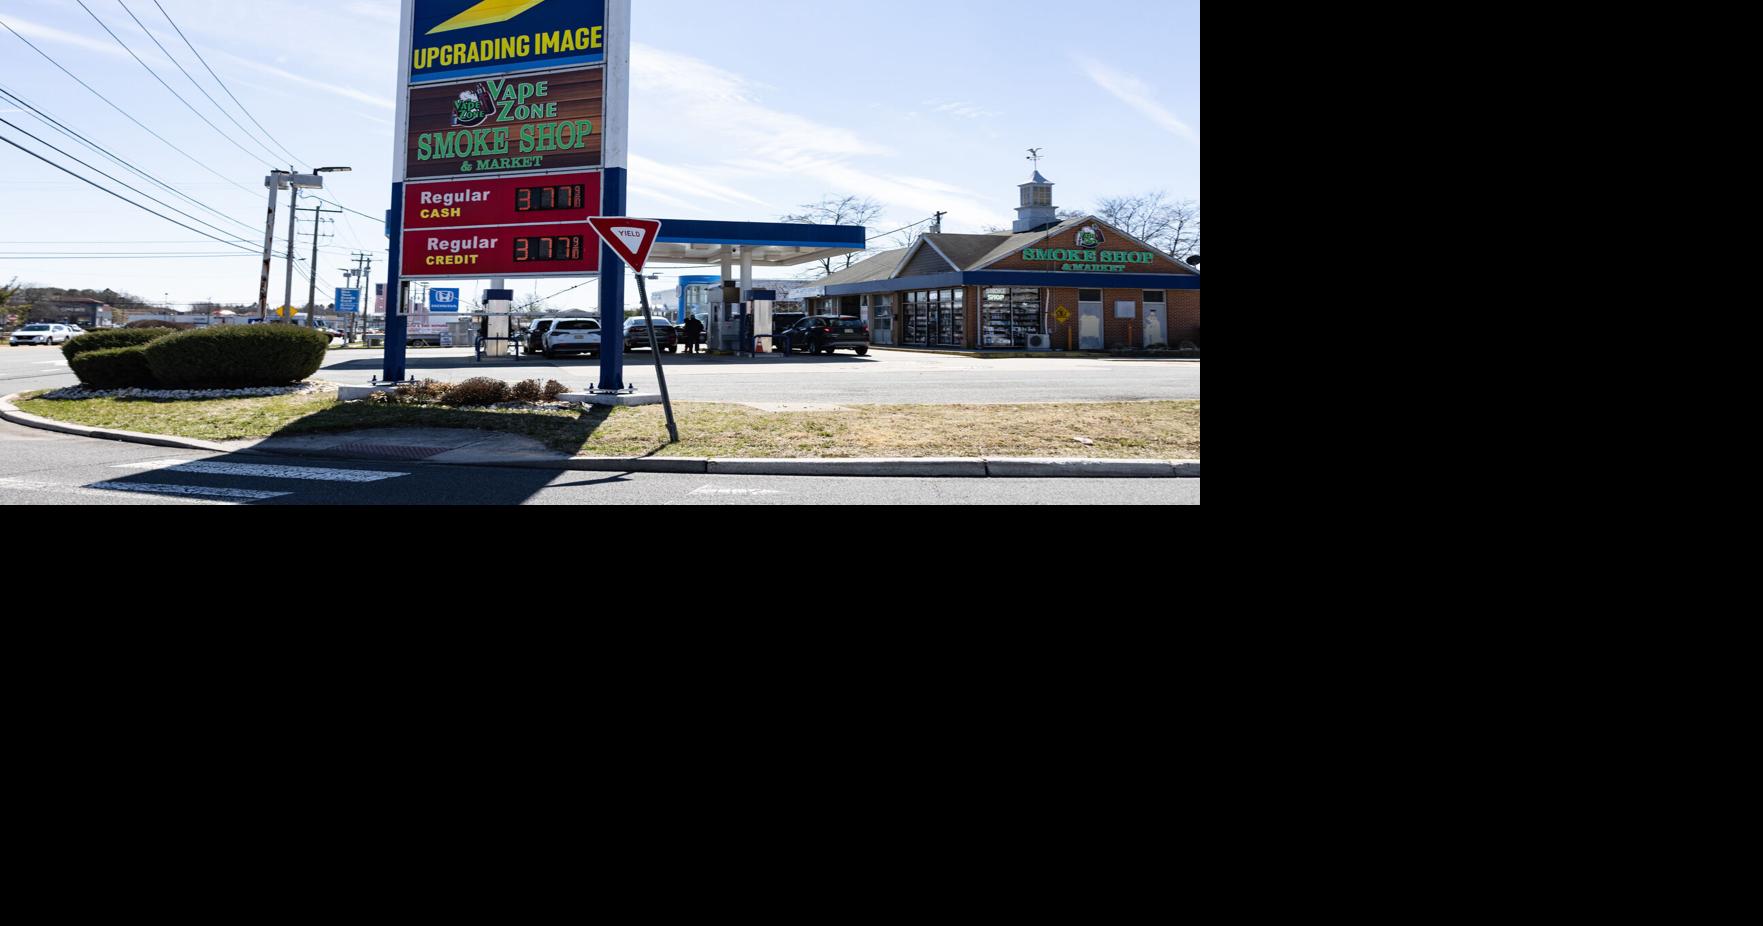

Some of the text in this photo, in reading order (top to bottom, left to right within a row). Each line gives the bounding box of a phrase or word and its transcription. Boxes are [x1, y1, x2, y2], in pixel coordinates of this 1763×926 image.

[413, 26, 602, 69] UPGRADING IMAGE
[417, 120, 593, 161] SMOKE SHOP
[460, 155, 543, 172] & MARKET
[420, 189, 490, 206] Regular
[420, 208, 461, 219] CASH
[618, 230, 641, 238] YIELD
[427, 236, 498, 253] Regular
[426, 255, 478, 266] CREDIT
[1022, 248, 1154, 264] SMOKE SHOP
[1072, 263, 1126, 272] MARKET
